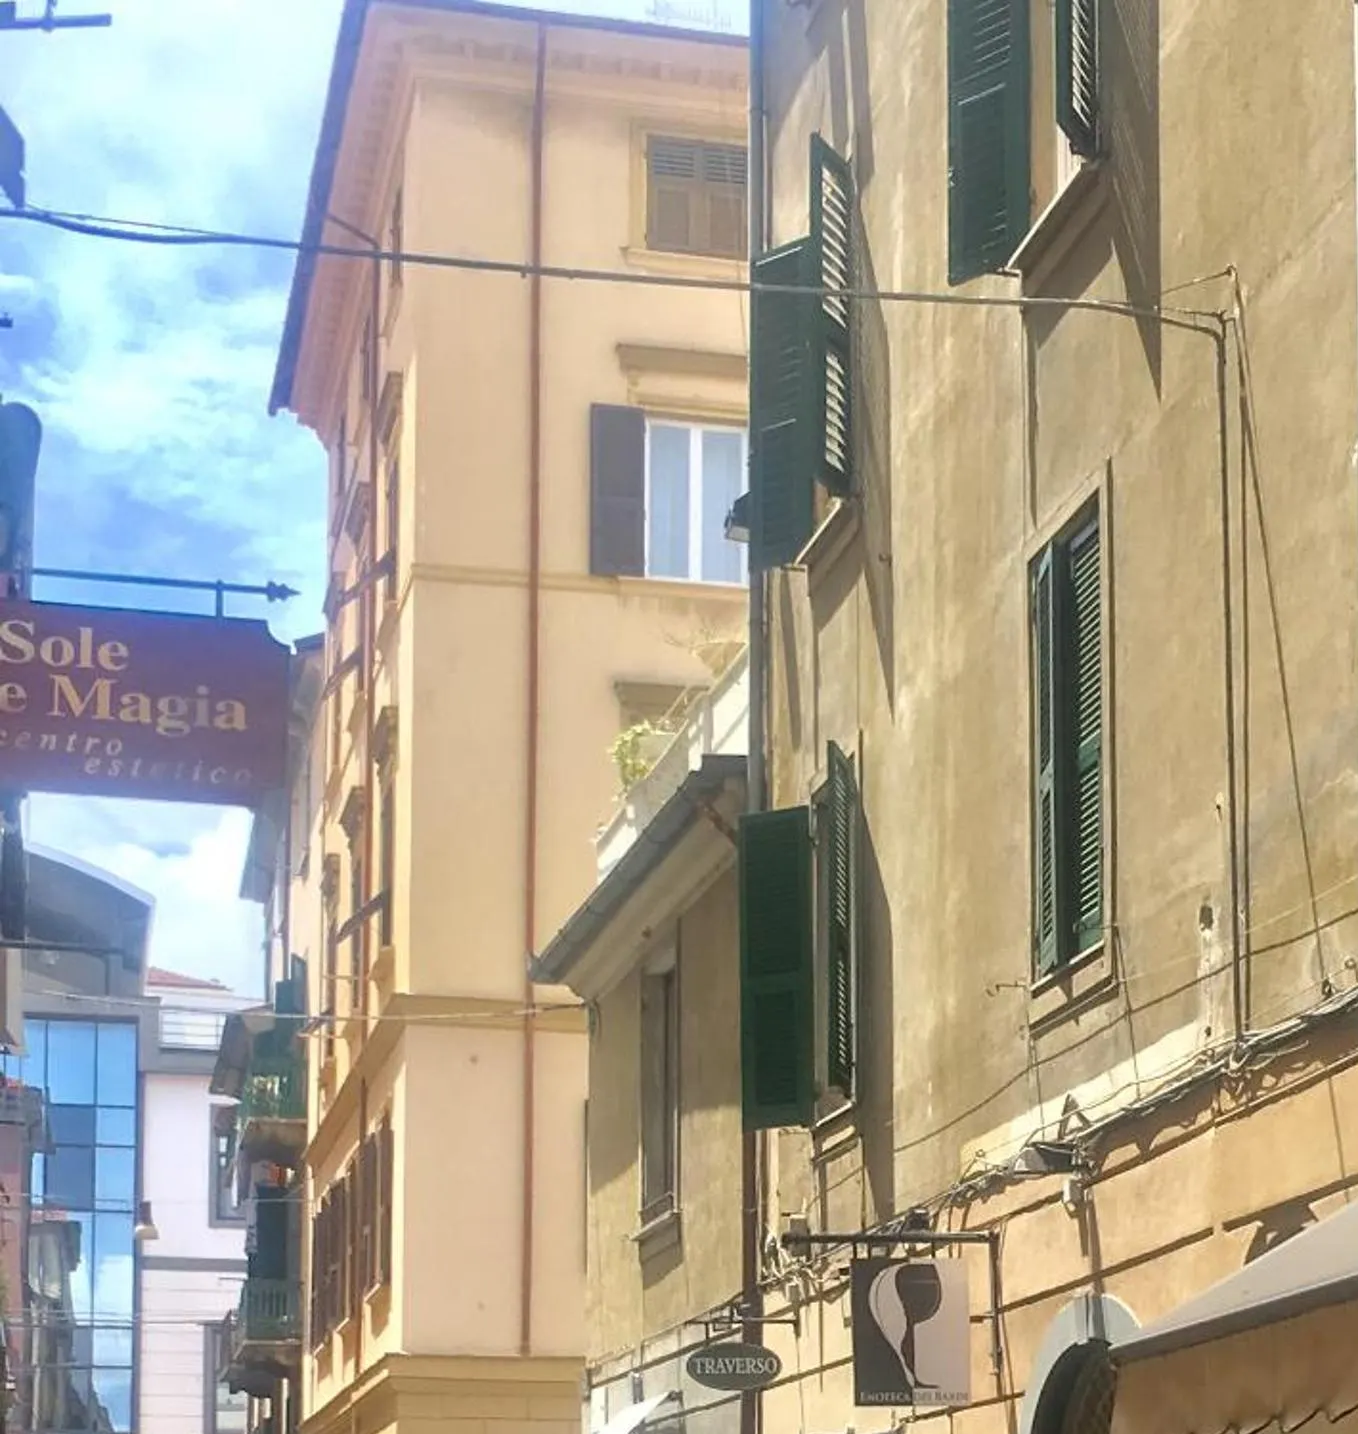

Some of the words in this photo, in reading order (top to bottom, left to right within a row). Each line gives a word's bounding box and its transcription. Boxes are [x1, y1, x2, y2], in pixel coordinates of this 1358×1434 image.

[0, 619, 129, 671] Sole
[0, 682, 28, 713] e
[46, 673, 249, 738] Magia
[695, 1357, 778, 1375] TRAVERSO
